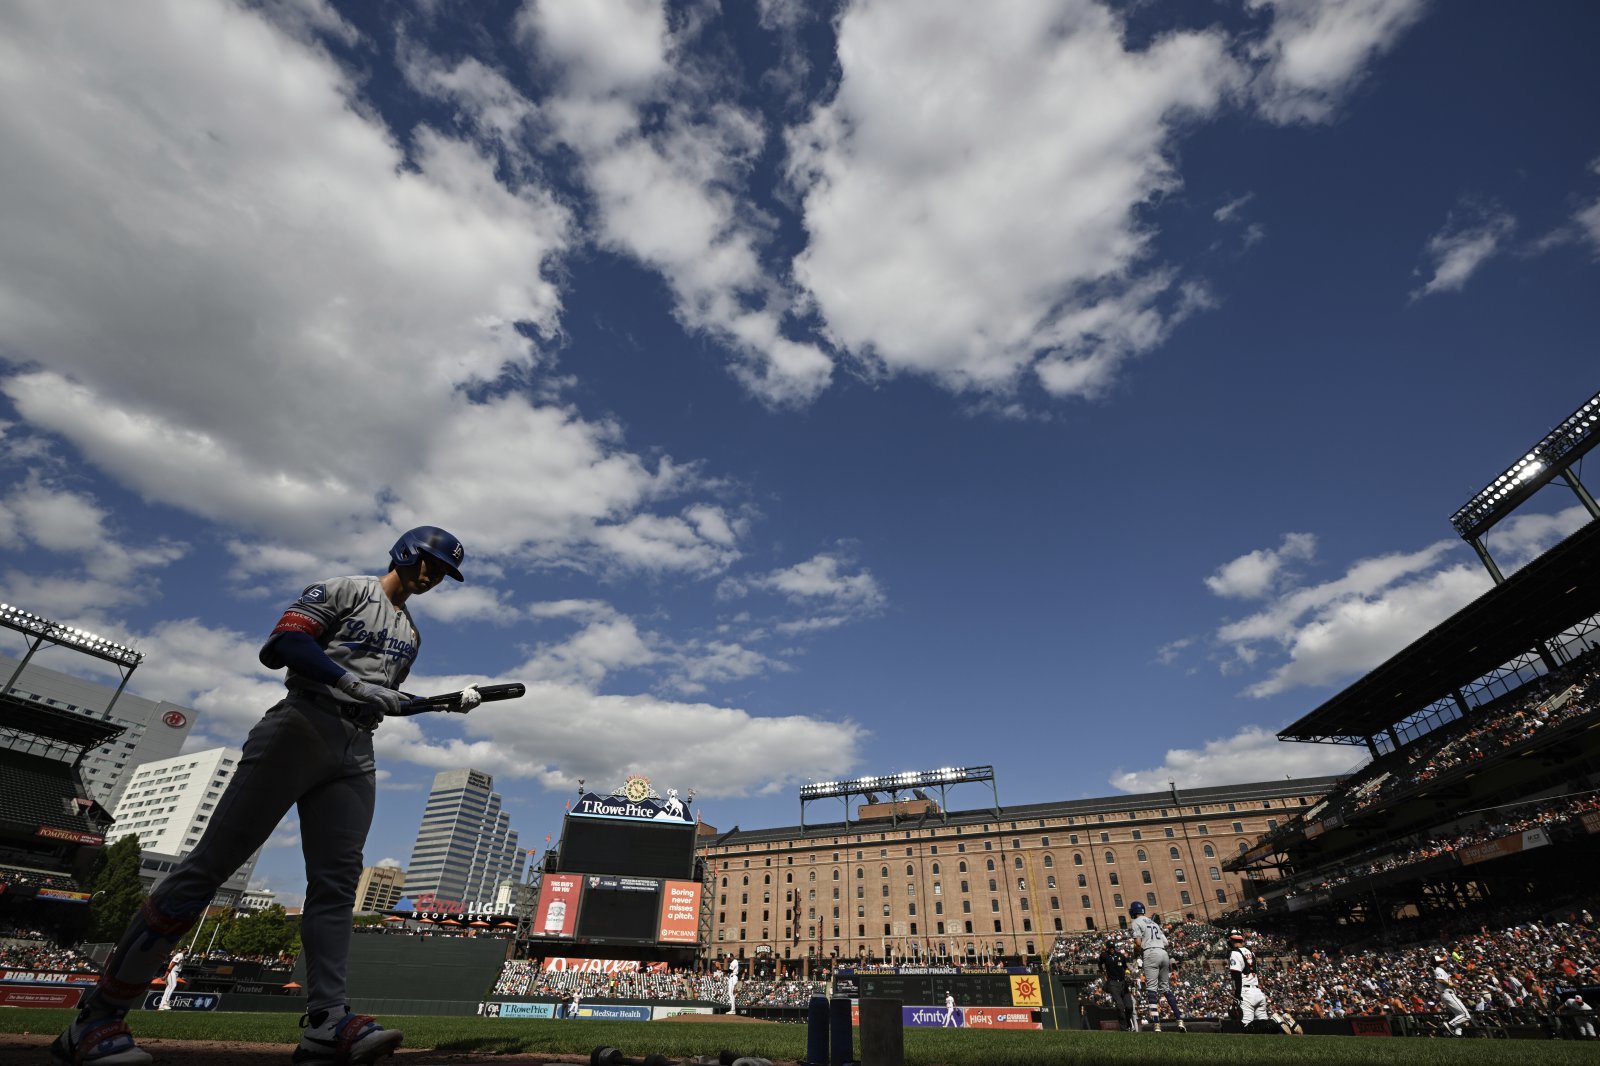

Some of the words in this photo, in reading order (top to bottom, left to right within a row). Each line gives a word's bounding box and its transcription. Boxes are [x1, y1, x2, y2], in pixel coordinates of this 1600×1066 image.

[452, 542, 462, 560] LA
[340, 618, 376, 644] Los
[39, 829, 80, 841] POMPEIAN
[671, 888, 695, 897] Boring
[467, 901, 516, 916] LIGHT
[669, 904, 694, 912] misses
[412, 911, 448, 919] ROOF
[458, 914, 492, 922] DECK
[674, 912, 695, 920] pitch.
[1146, 925, 1161, 940] 72
[4, 971, 35, 981] BIRD
[36, 972, 68, 982] BATH
[899, 967, 928, 975] MARINER
[928, 967, 957, 975] FINANCE
[236, 984, 264, 993] Trusted
[152, 995, 193, 1008] CeFirst
[592, 1009, 620, 1017] MedStar
[620, 1010, 641, 1018] Health
[912, 1009, 949, 1025] xfinity
[969, 1014, 993, 1025] HIGH'S
